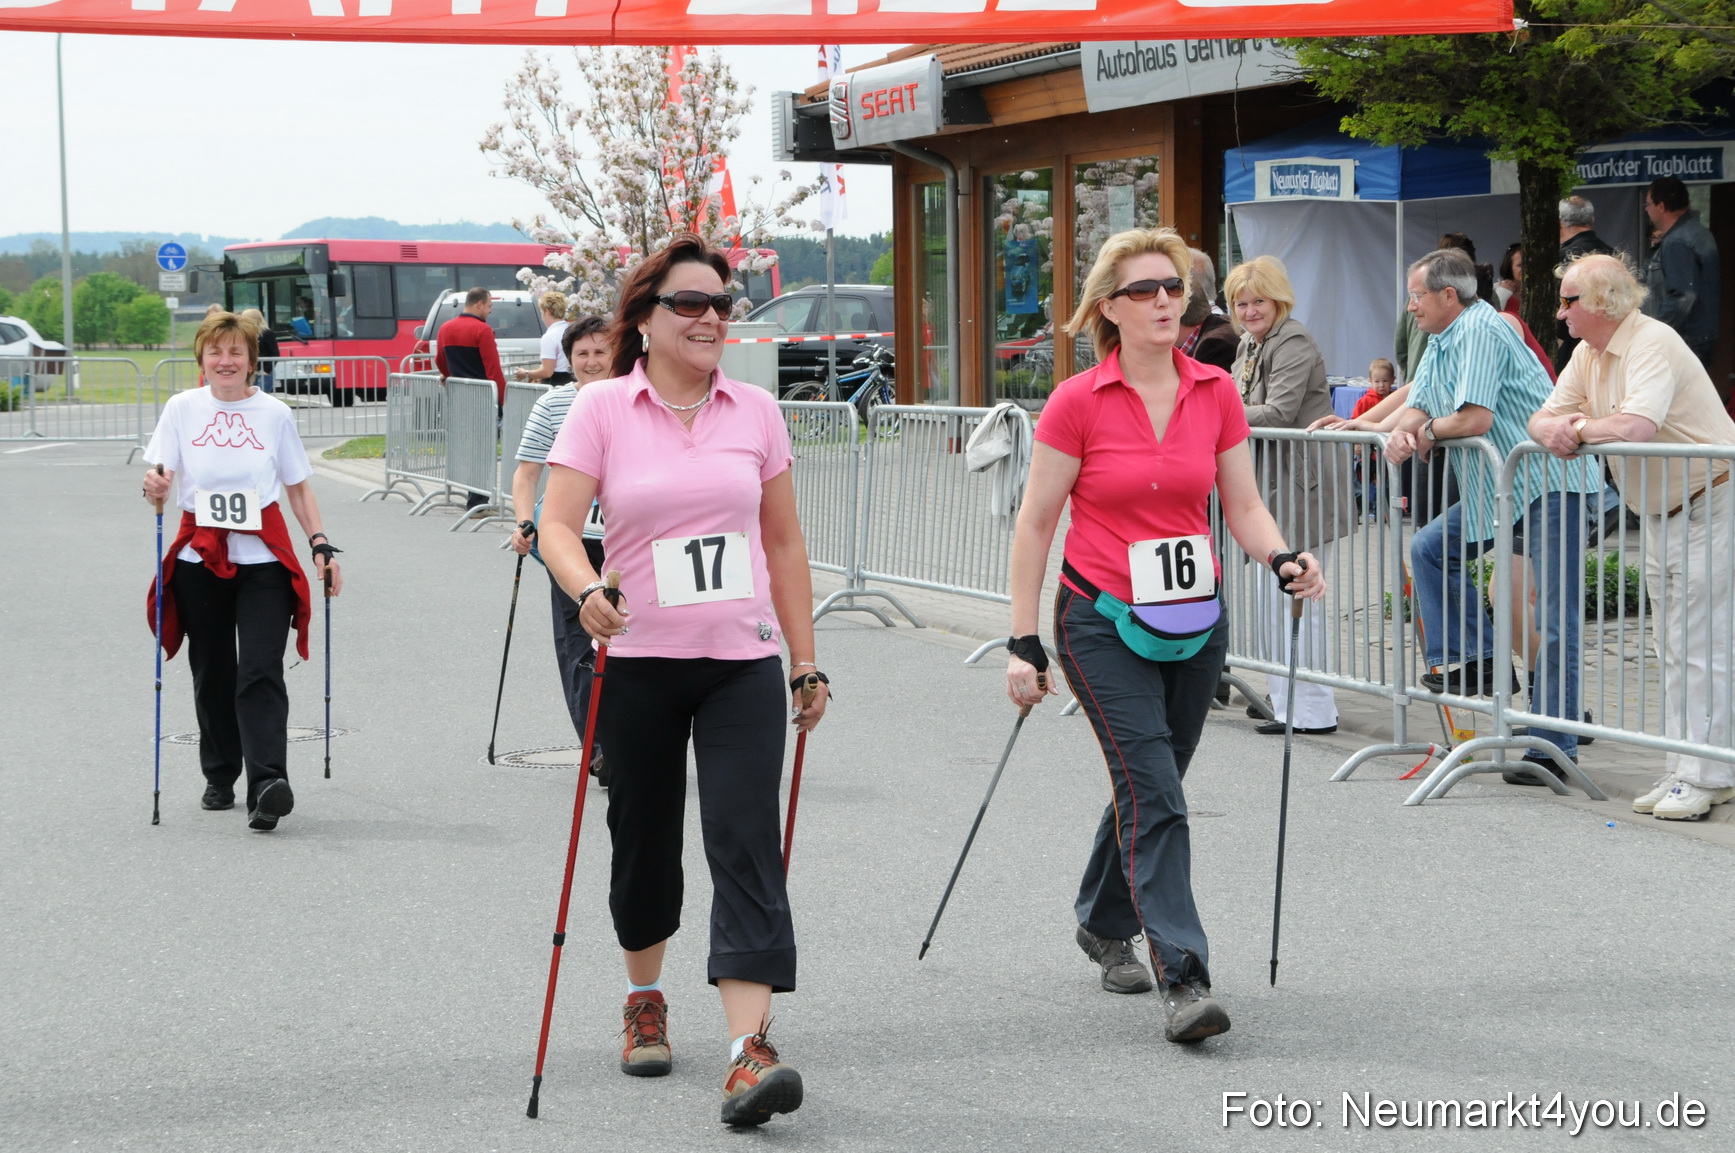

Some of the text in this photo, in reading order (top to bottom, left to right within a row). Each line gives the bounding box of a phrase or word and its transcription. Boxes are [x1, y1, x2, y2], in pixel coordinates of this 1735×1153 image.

[1096, 41, 1178, 82] Autohaus
[861, 81, 919, 120] SEAT
[1310, 169, 1339, 193] Tagblatt
[1572, 154, 1714, 179] markter Tagblatt
[209, 492, 247, 525] 99
[684, 535, 726, 593] 17
[1155, 539, 1196, 592] 16
